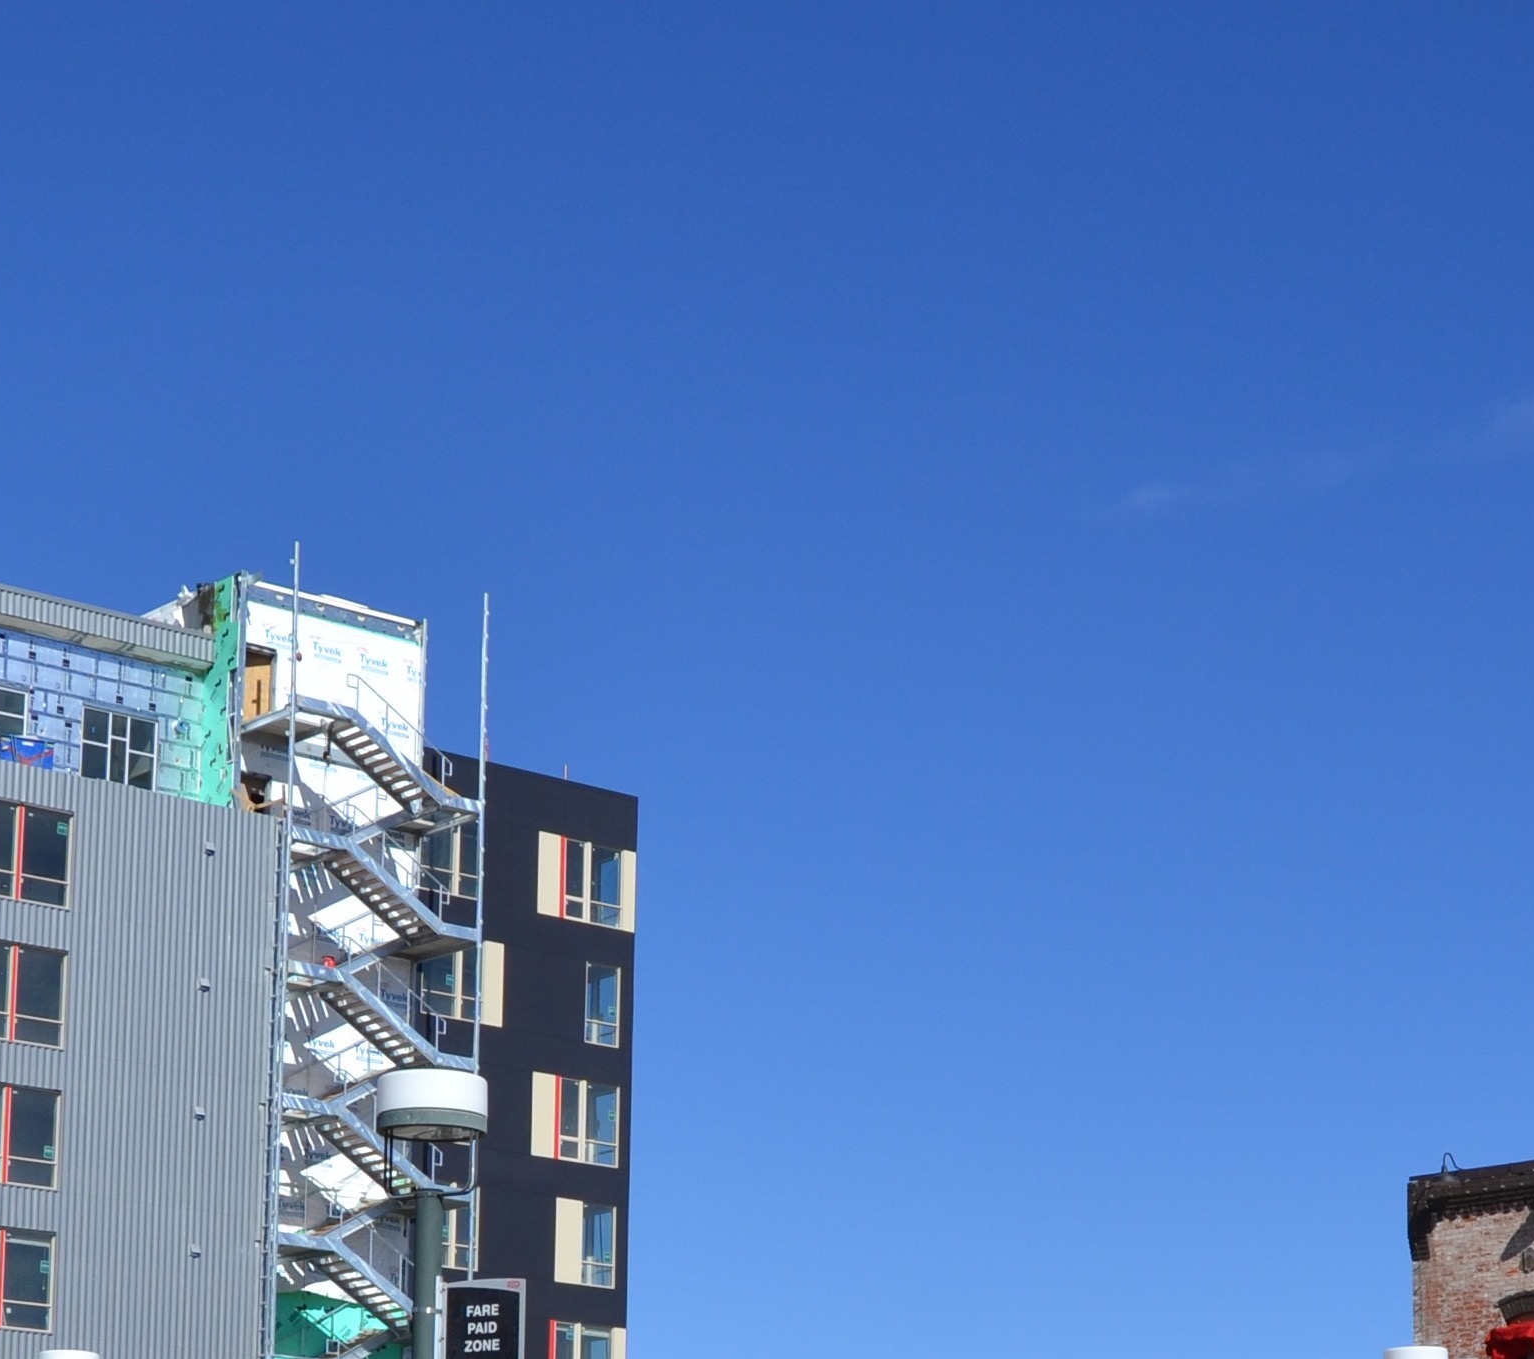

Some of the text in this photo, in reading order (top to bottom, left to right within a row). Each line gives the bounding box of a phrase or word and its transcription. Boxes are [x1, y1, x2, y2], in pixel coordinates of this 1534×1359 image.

[313, 641, 341, 657] Tyvek
[359, 653, 388, 668] Tyvek
[466, 1304, 499, 1318] FARE
[467, 1321, 498, 1335] PAID
[464, 1338, 501, 1353] ZONE
